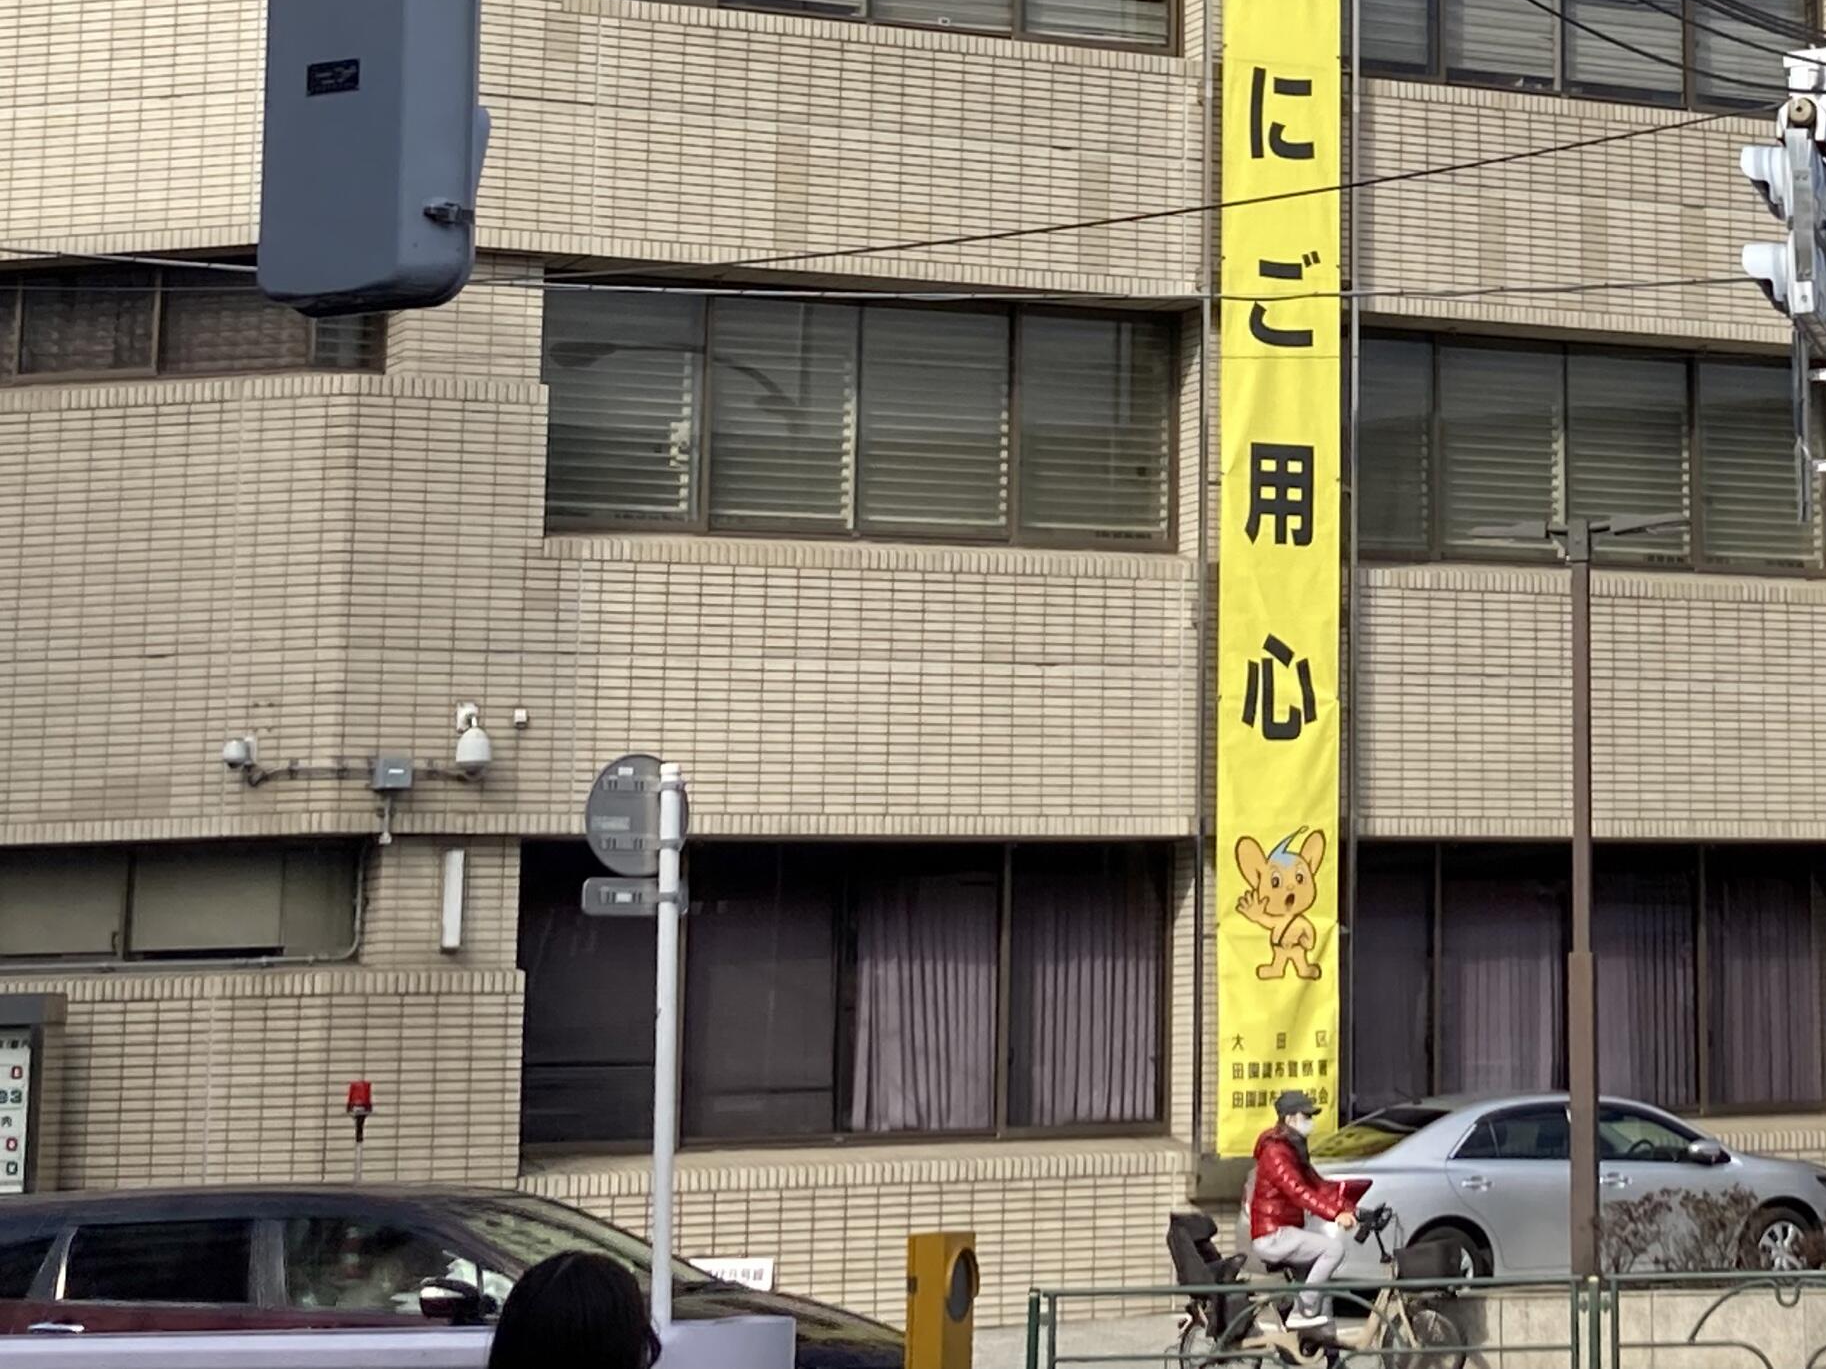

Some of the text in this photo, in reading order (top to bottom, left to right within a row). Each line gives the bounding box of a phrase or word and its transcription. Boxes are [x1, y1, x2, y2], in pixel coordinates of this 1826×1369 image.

[1232, 1060, 1328, 1080] 田園調布警察署
